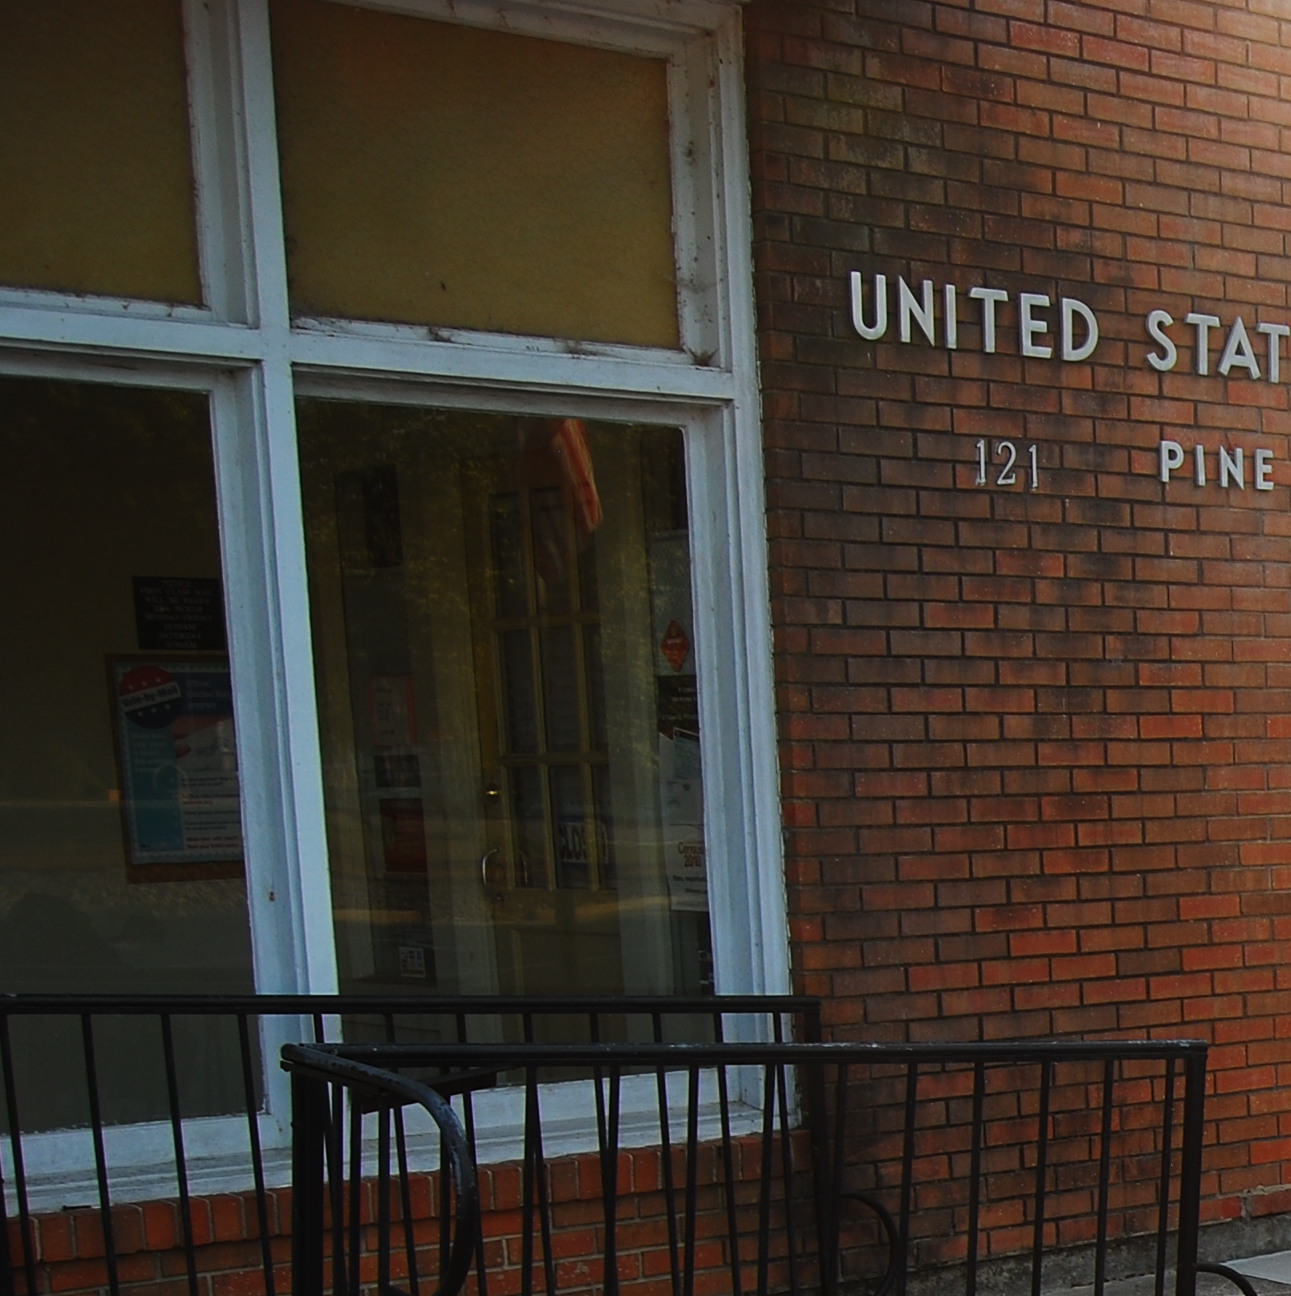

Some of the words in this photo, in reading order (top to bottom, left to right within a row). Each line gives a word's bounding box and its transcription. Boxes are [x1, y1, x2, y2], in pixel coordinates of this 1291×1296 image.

[850, 271, 1099, 362] UNITED
[976, 439, 1038, 489] 121
[1160, 440, 1275, 491] PINE
